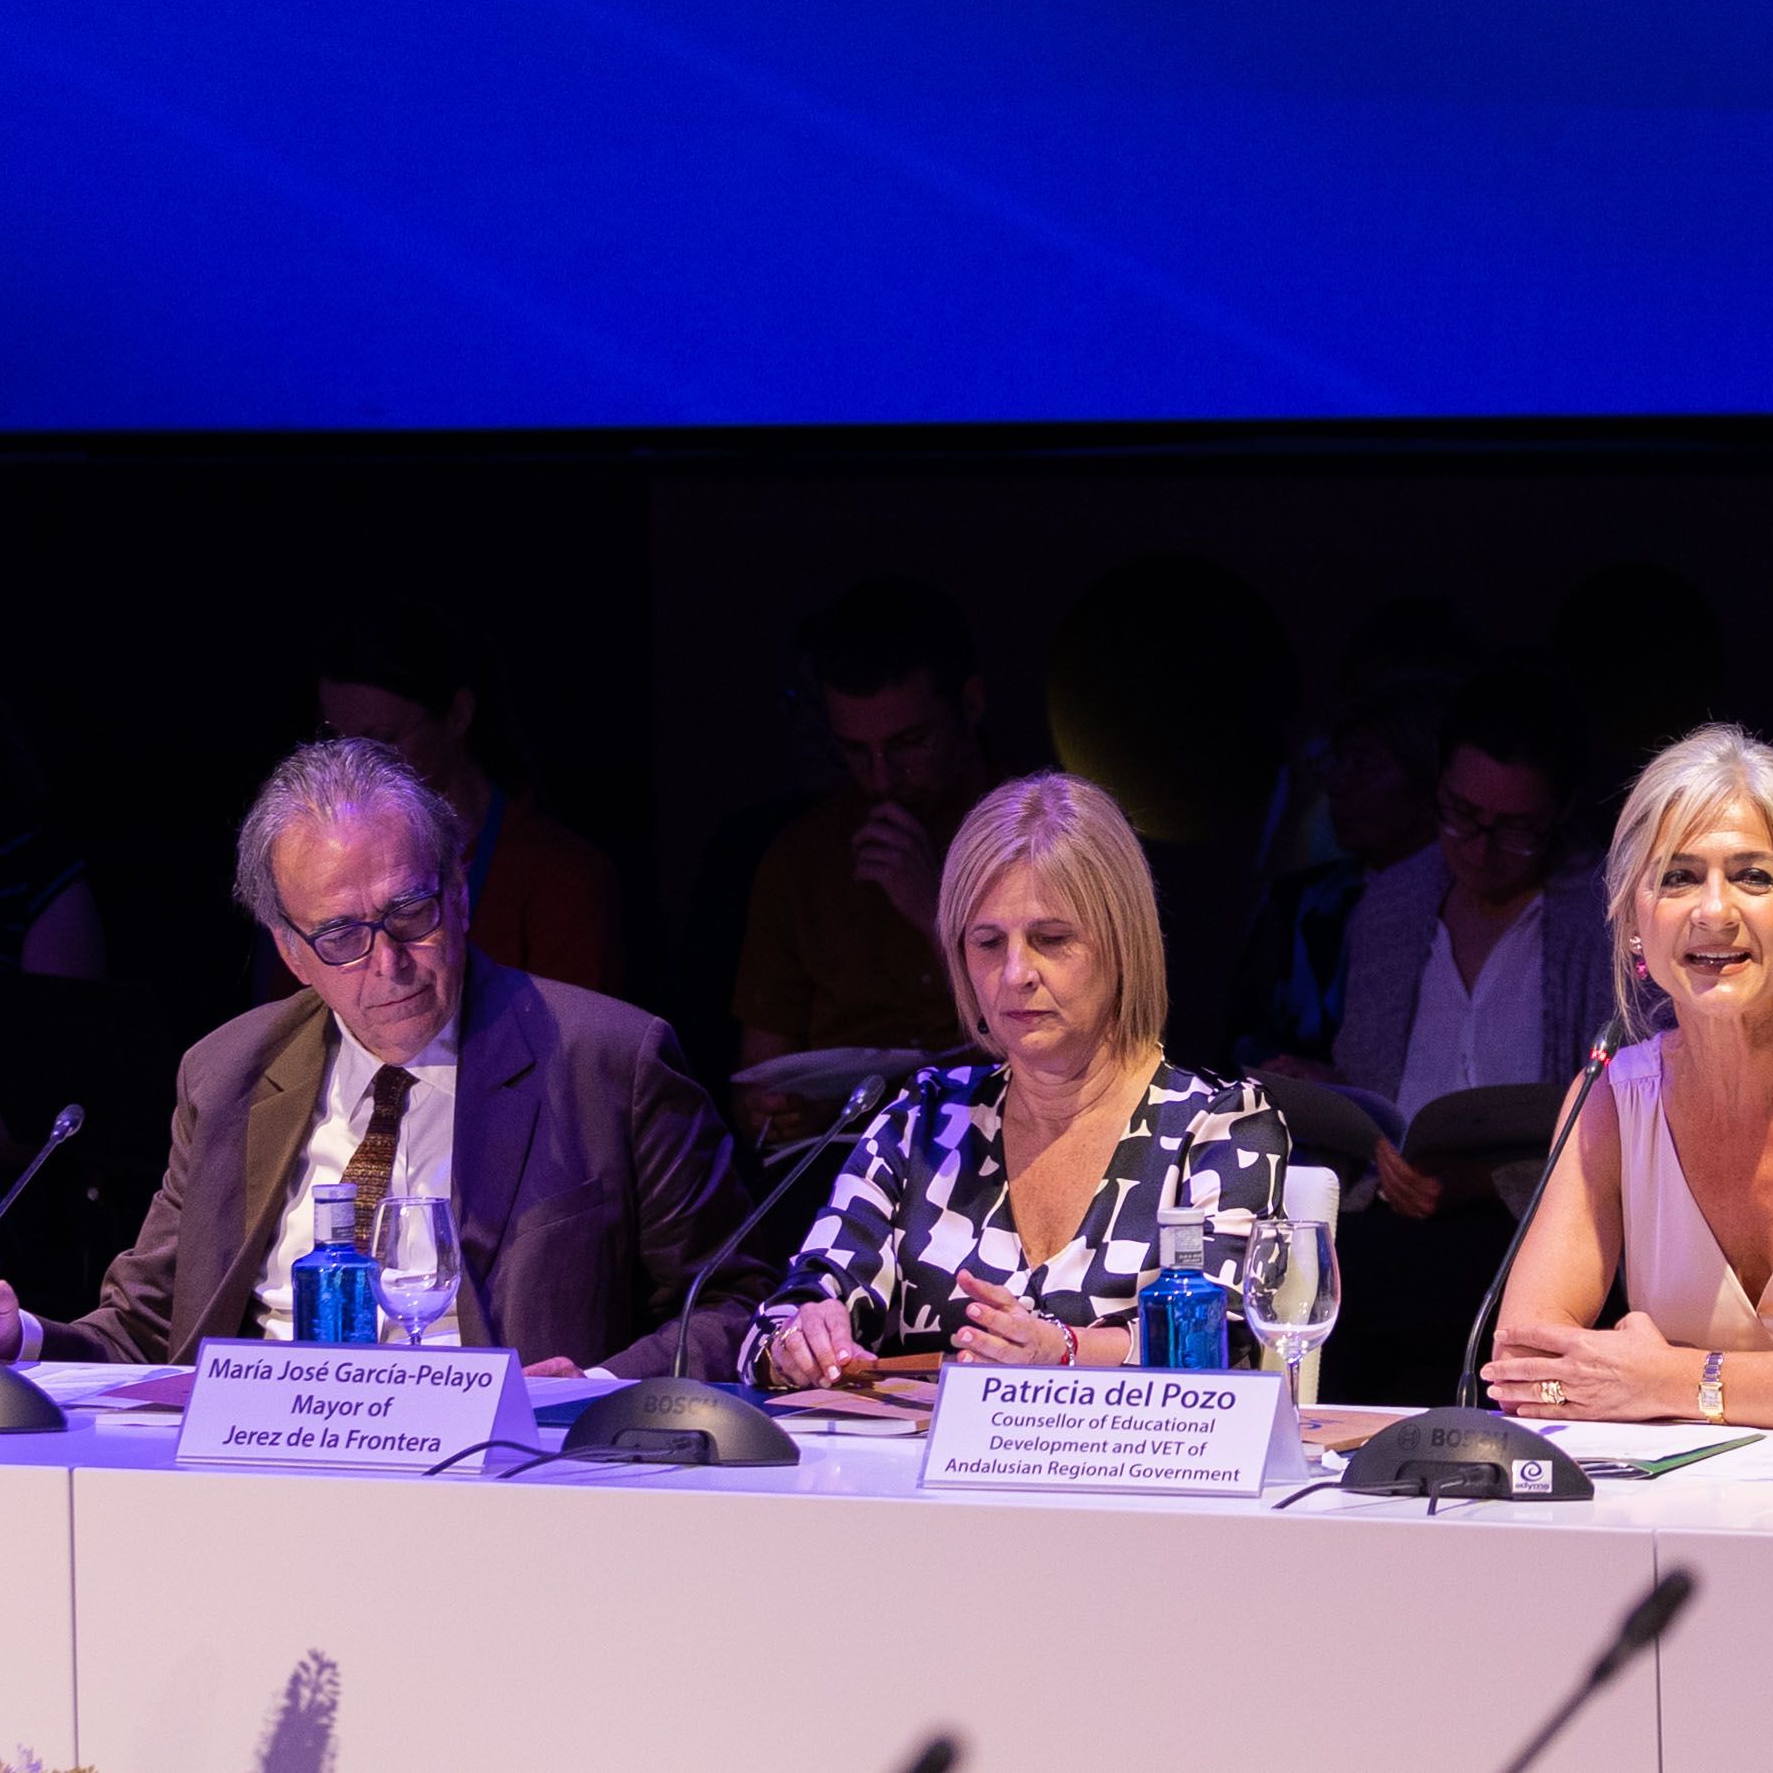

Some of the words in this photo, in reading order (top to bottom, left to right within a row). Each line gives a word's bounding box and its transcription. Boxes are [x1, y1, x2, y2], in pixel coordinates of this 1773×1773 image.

[208, 1357, 273, 1380] María
[277, 1359, 329, 1382] José
[335, 1361, 493, 1393] García-Pelayo
[981, 1377, 1095, 1406] Patricia
[1104, 1380, 1155, 1407] del
[1161, 1382, 1237, 1410] Pozo
[290, 1394, 364, 1421] Mayor
[368, 1396, 395, 1418] of
[991, 1411, 1085, 1430] Counsellor
[1088, 1413, 1109, 1430] of
[1110, 1414, 1216, 1434] Educational
[222, 1425, 282, 1447] Jerez
[286, 1426, 315, 1448] de
[319, 1427, 339, 1449] la
[345, 1429, 441, 1453] Frontera
[989, 1435, 1108, 1456] Development
[1112, 1438, 1146, 1456] and
[1150, 1440, 1185, 1456] VET
[1187, 1440, 1208, 1457] of
[944, 1458, 1043, 1477] Andalusian
[1047, 1461, 1125, 1480] Regional
[1129, 1463, 1241, 1483] Government
